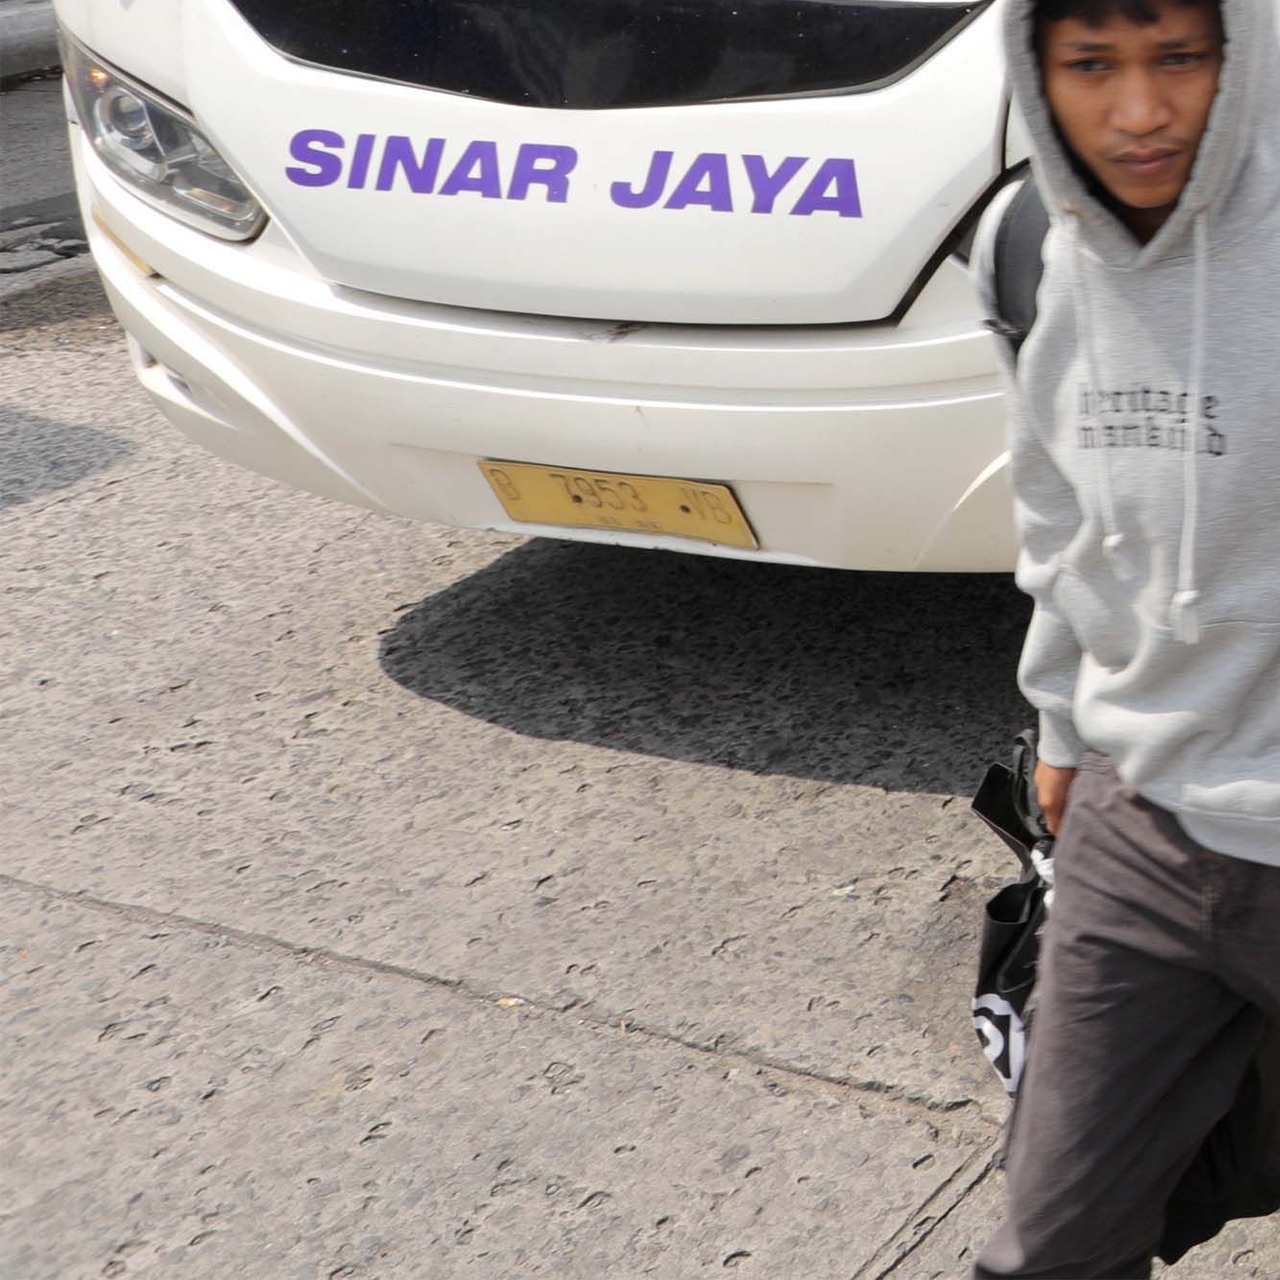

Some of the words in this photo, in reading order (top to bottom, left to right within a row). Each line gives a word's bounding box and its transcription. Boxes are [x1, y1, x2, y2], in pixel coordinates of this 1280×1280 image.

[285, 128, 579, 204] SINAR
[609, 149, 864, 219] JAYA
[489, 468, 521, 502] B
